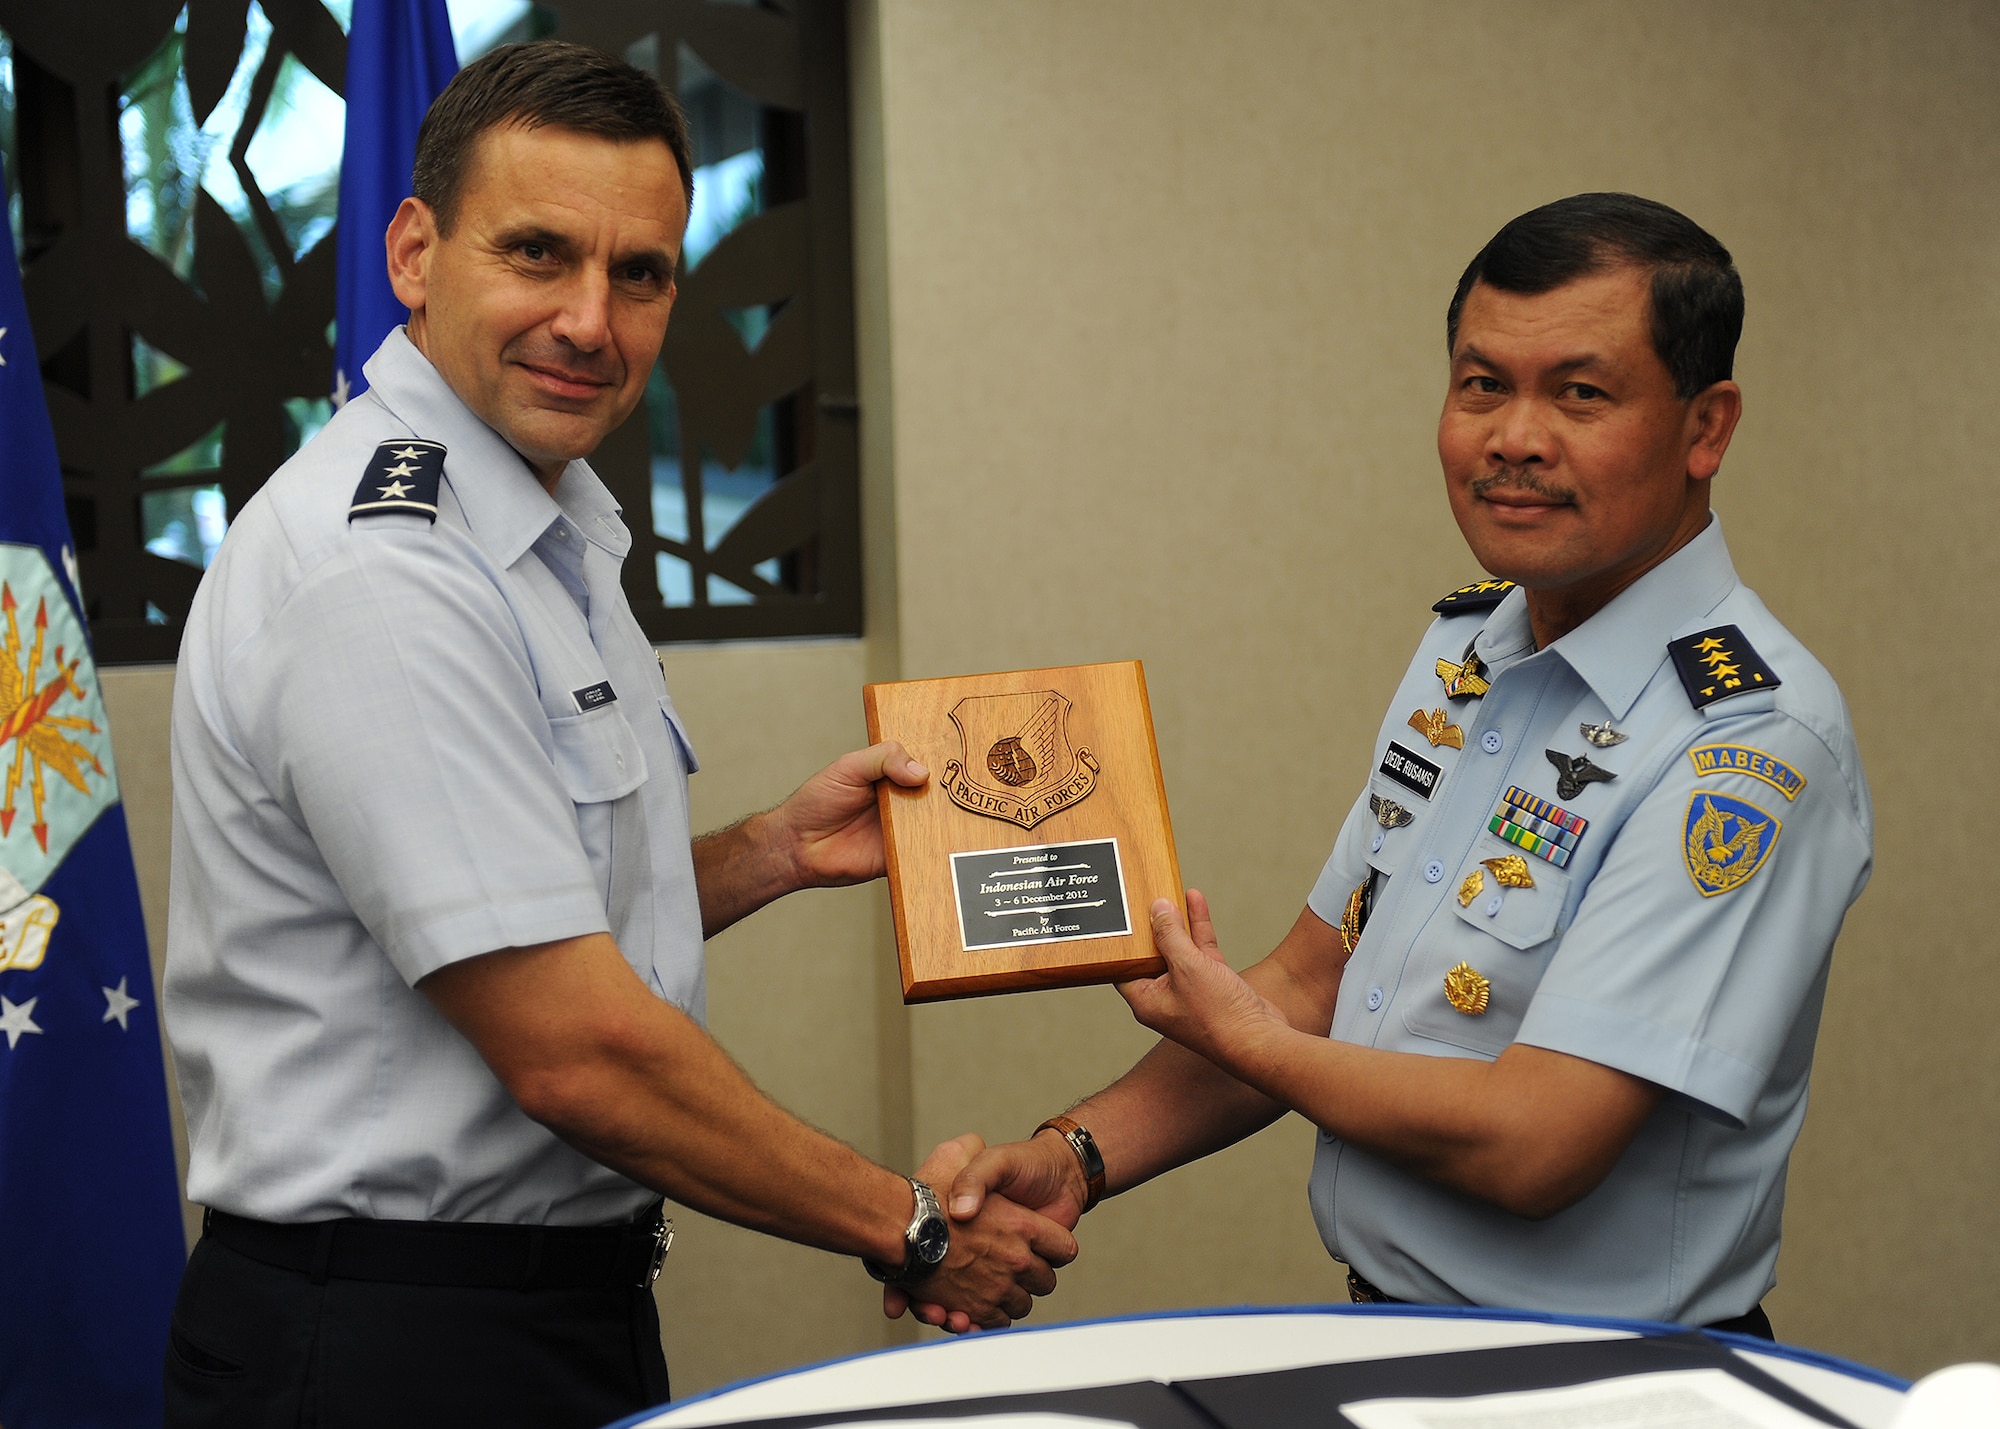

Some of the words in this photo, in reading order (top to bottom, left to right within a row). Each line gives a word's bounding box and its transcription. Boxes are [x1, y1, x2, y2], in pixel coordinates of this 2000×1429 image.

[1384, 749, 1406, 772] DEDE
[1402, 760, 1436, 788] RUSAMSI
[1697, 749, 1801, 792] MABESAU
[955, 781, 1009, 813] PACIFIC
[1014, 806, 1041, 822] AIR
[1044, 772, 1090, 809] FORCES
[1012, 853, 1048, 865] Presented
[979, 881, 1043, 894] Indonesian
[1044, 876, 1066, 888] Air
[1068, 874, 1099, 885] Force
[994, 898, 1001, 907] 3
[1013, 896, 1020, 905] 6
[1021, 892, 1064, 904] December
[1066, 890, 1089, 900] 2012
[1011, 926, 1039, 937] Pacific
[1040, 925, 1053, 935] Air
[1054, 923, 1080, 933] Forces
[1040, 916, 1050, 926] by
